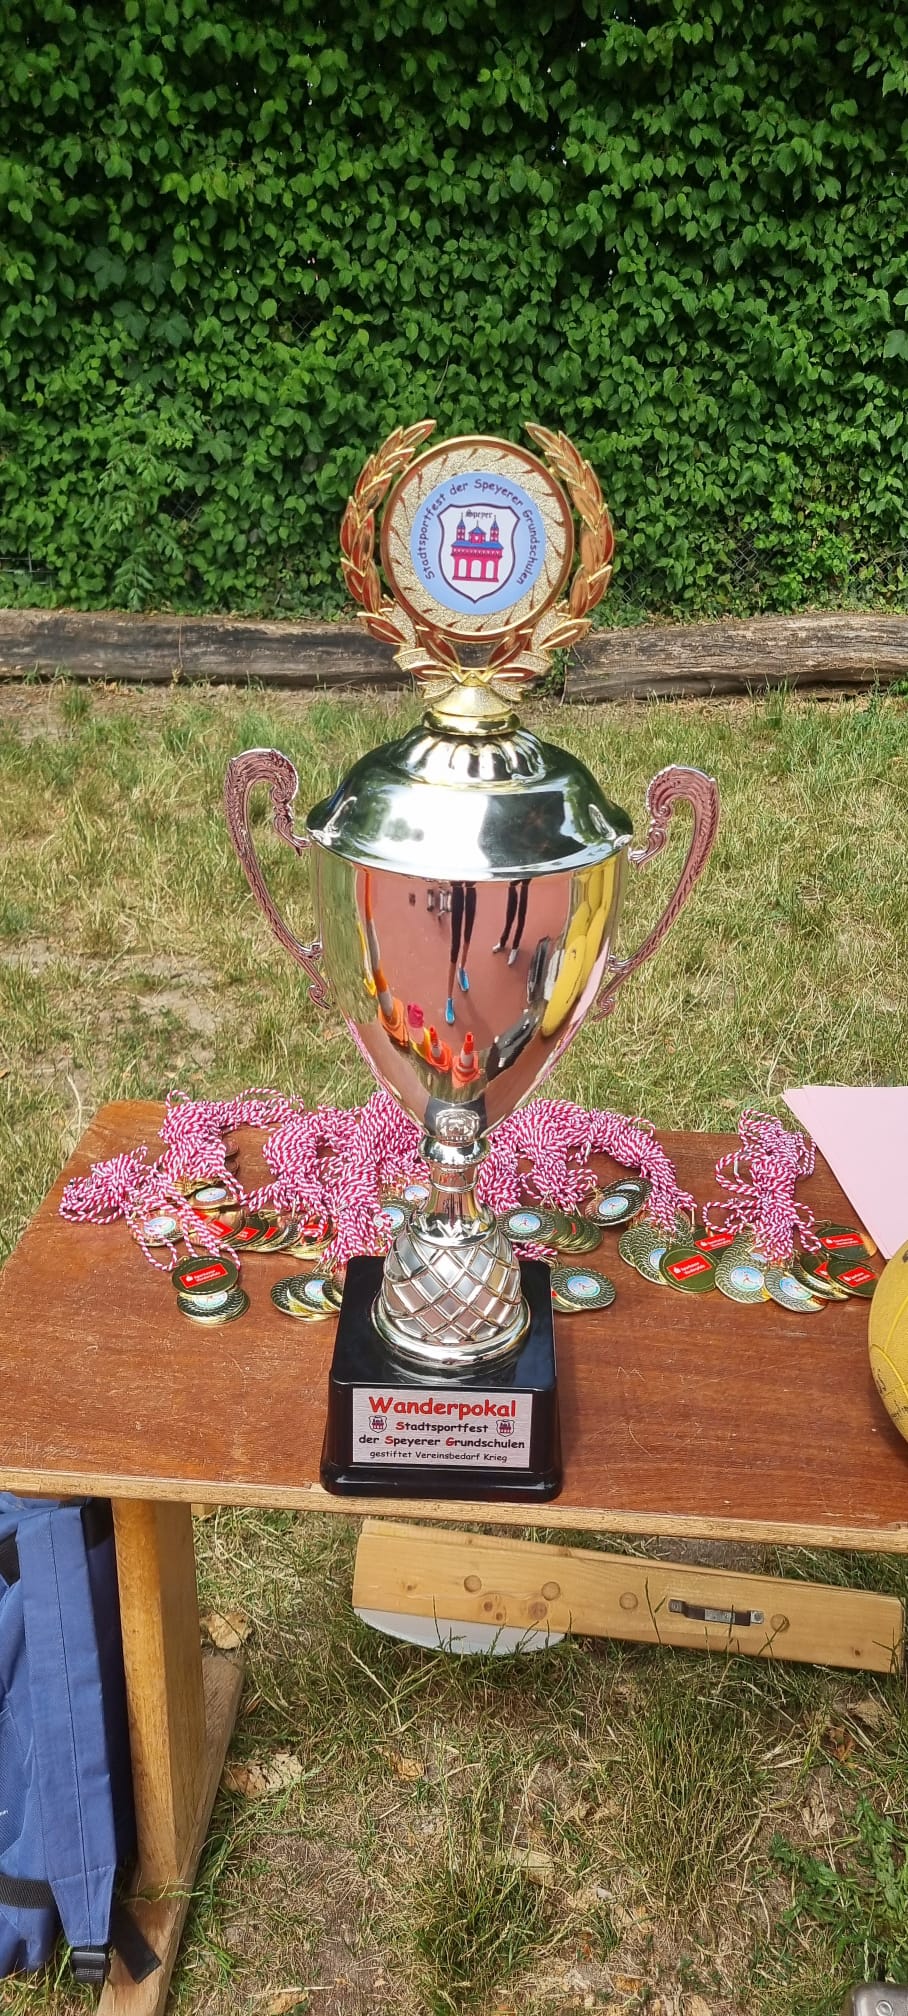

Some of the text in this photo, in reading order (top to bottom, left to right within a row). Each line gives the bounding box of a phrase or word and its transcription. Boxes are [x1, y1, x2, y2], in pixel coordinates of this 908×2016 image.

[465, 509, 493, 520] Speyer
[417, 478, 541, 585] Stadtsportfest der Speyerer Grundschulen
[368, 1396, 516, 1421] Wanderpokal
[395, 1421, 489, 1434] Stadtsportfest
[358, 1434, 525, 1449] der Speyerer Grundschulen
[369, 1450, 508, 1463] gestiftet Vereinsbedarf Krieg
